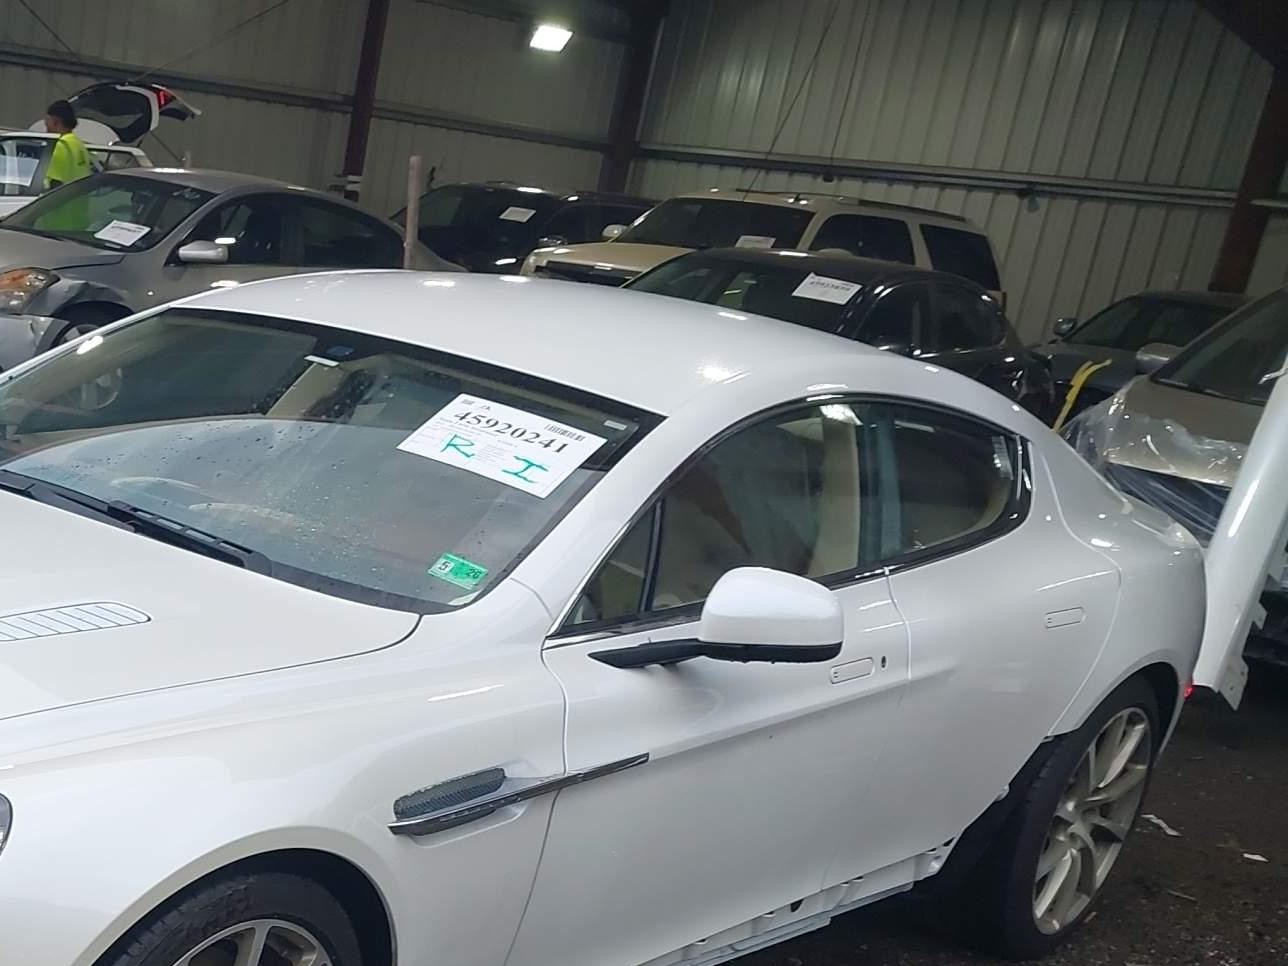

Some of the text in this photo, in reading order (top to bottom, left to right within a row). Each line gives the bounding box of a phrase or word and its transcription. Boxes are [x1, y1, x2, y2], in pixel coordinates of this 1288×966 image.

[453, 411, 569, 453] 45920241
[440, 434, 475, 458] R
[438, 560, 482, 580] 5 26
